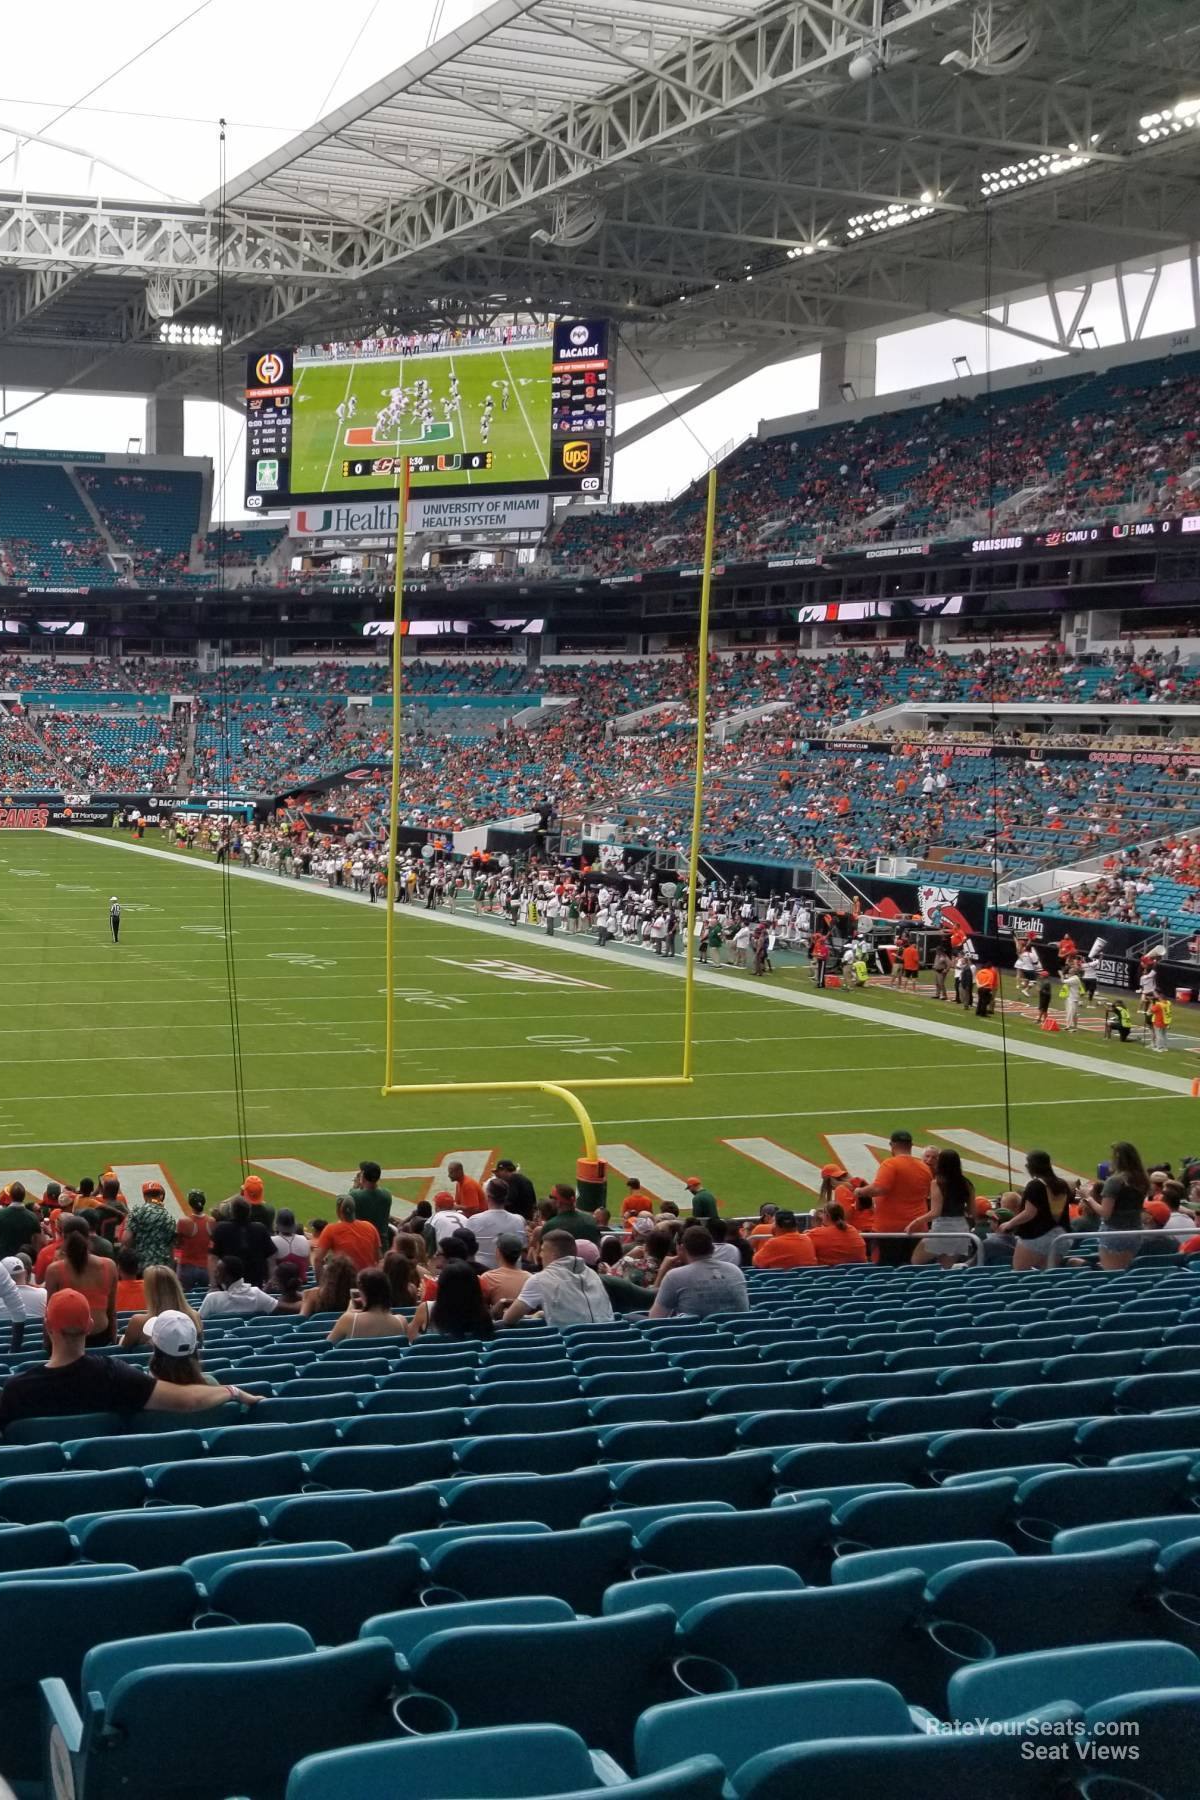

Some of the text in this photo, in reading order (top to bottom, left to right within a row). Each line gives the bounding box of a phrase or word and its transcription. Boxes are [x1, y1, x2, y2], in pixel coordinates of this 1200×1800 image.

[560, 344, 598, 358] BACARDÍ
[566, 451, 587, 467] ups
[423, 499, 540, 516] UNIVERSITY OF MIAMI
[422, 514, 506, 528] HEALTH SYSTEM
[1065, 530, 1088, 543] CMU
[1135, 524, 1154, 535] MIA
[972, 536, 1022, 552] SAMSUNG
[332, 585, 366, 594] RING
[997, 914, 1043, 934] UHealth
